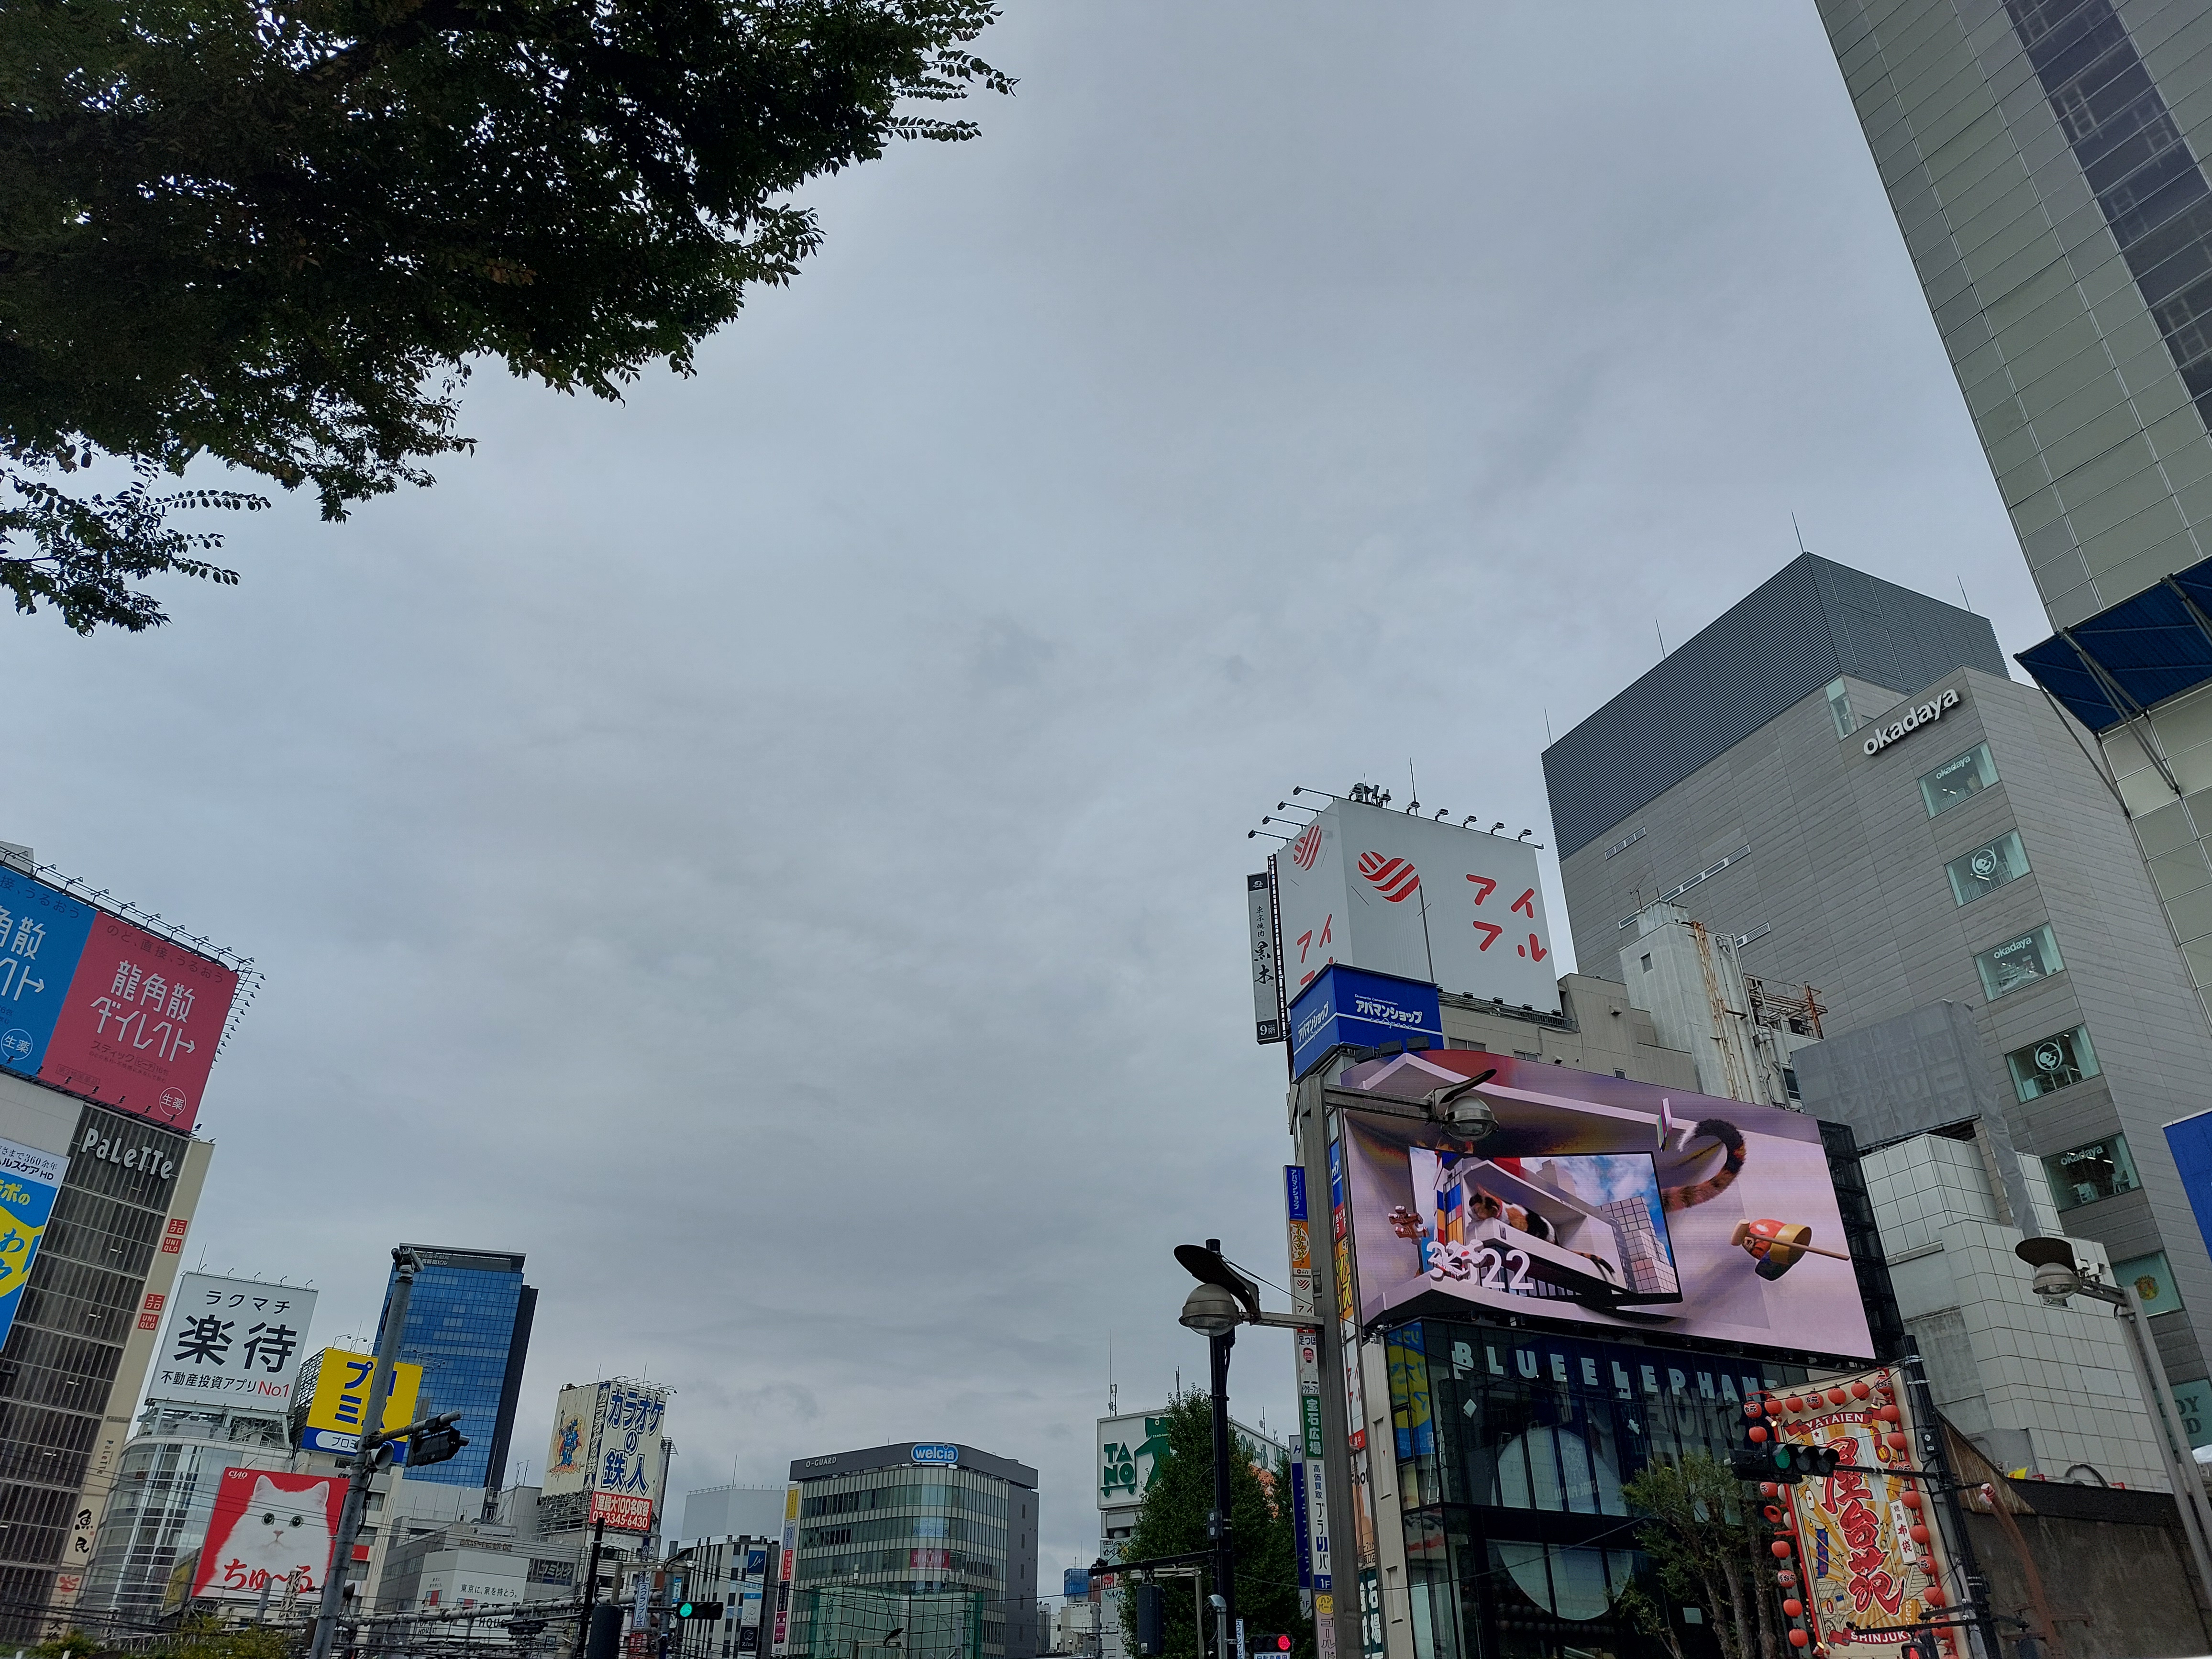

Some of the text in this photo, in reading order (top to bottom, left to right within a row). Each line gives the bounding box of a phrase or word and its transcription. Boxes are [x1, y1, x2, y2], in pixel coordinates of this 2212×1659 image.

[1863, 689, 1959, 755] okadaya
[1936, 755, 1971, 780] okadaya
[107, 925, 223, 983] のど、直接、うるおう
[1993, 936, 2033, 959] okadaya
[1253, 940, 1274, 984] 黒木
[111, 960, 195, 1023] 龍角散
[1298, 1001, 1329, 1043] アパマンショップ
[1356, 1000, 1422, 1024] アパマンショップ
[90, 996, 195, 1062] ダイレクト
[1260, 1024, 1276, 1038] 9階
[3, 1035, 31, 1054] 生薬
[161, 1093, 184, 1110] 生薬
[2060, 1145, 2104, 1167] okadaya
[165, 1238, 179, 1247] UNI
[206, 1290, 290, 1314] ラクマチ
[142, 1315, 156, 1324] UNI
[173, 1314, 297, 1373] 楽待
[606, 1385, 665, 1436] カラオケ
[1805, 1413, 1864, 1431] YATAIEN
[1307, 1397, 1321, 1455] 宝石広場
[584, 1386, 609, 1491] カラオケの鉄人
[624, 1428, 639, 1456] の
[805, 1457, 837, 1468] O-GUARD
[915, 1444, 955, 1460] welcia
[600, 1448, 649, 1496] 鉄人
[1313, 1464, 1323, 1499] 高価買取
[595, 1495, 651, 1516] 1室最大100名収容
[75, 1509, 93, 1553] 魚民
[592, 1511, 648, 1528] 03-3345-6430
[1316, 1502, 1327, 1570] ブラリバ
[539, 1564, 573, 1577] コミック
[460, 1583, 517, 1598] 東京に、家を持とう。
[1320, 1578, 1330, 1589] 1F
[635, 1584, 648, 1626] スクランブル式
[1303, 1600, 1309, 1608] 1F
